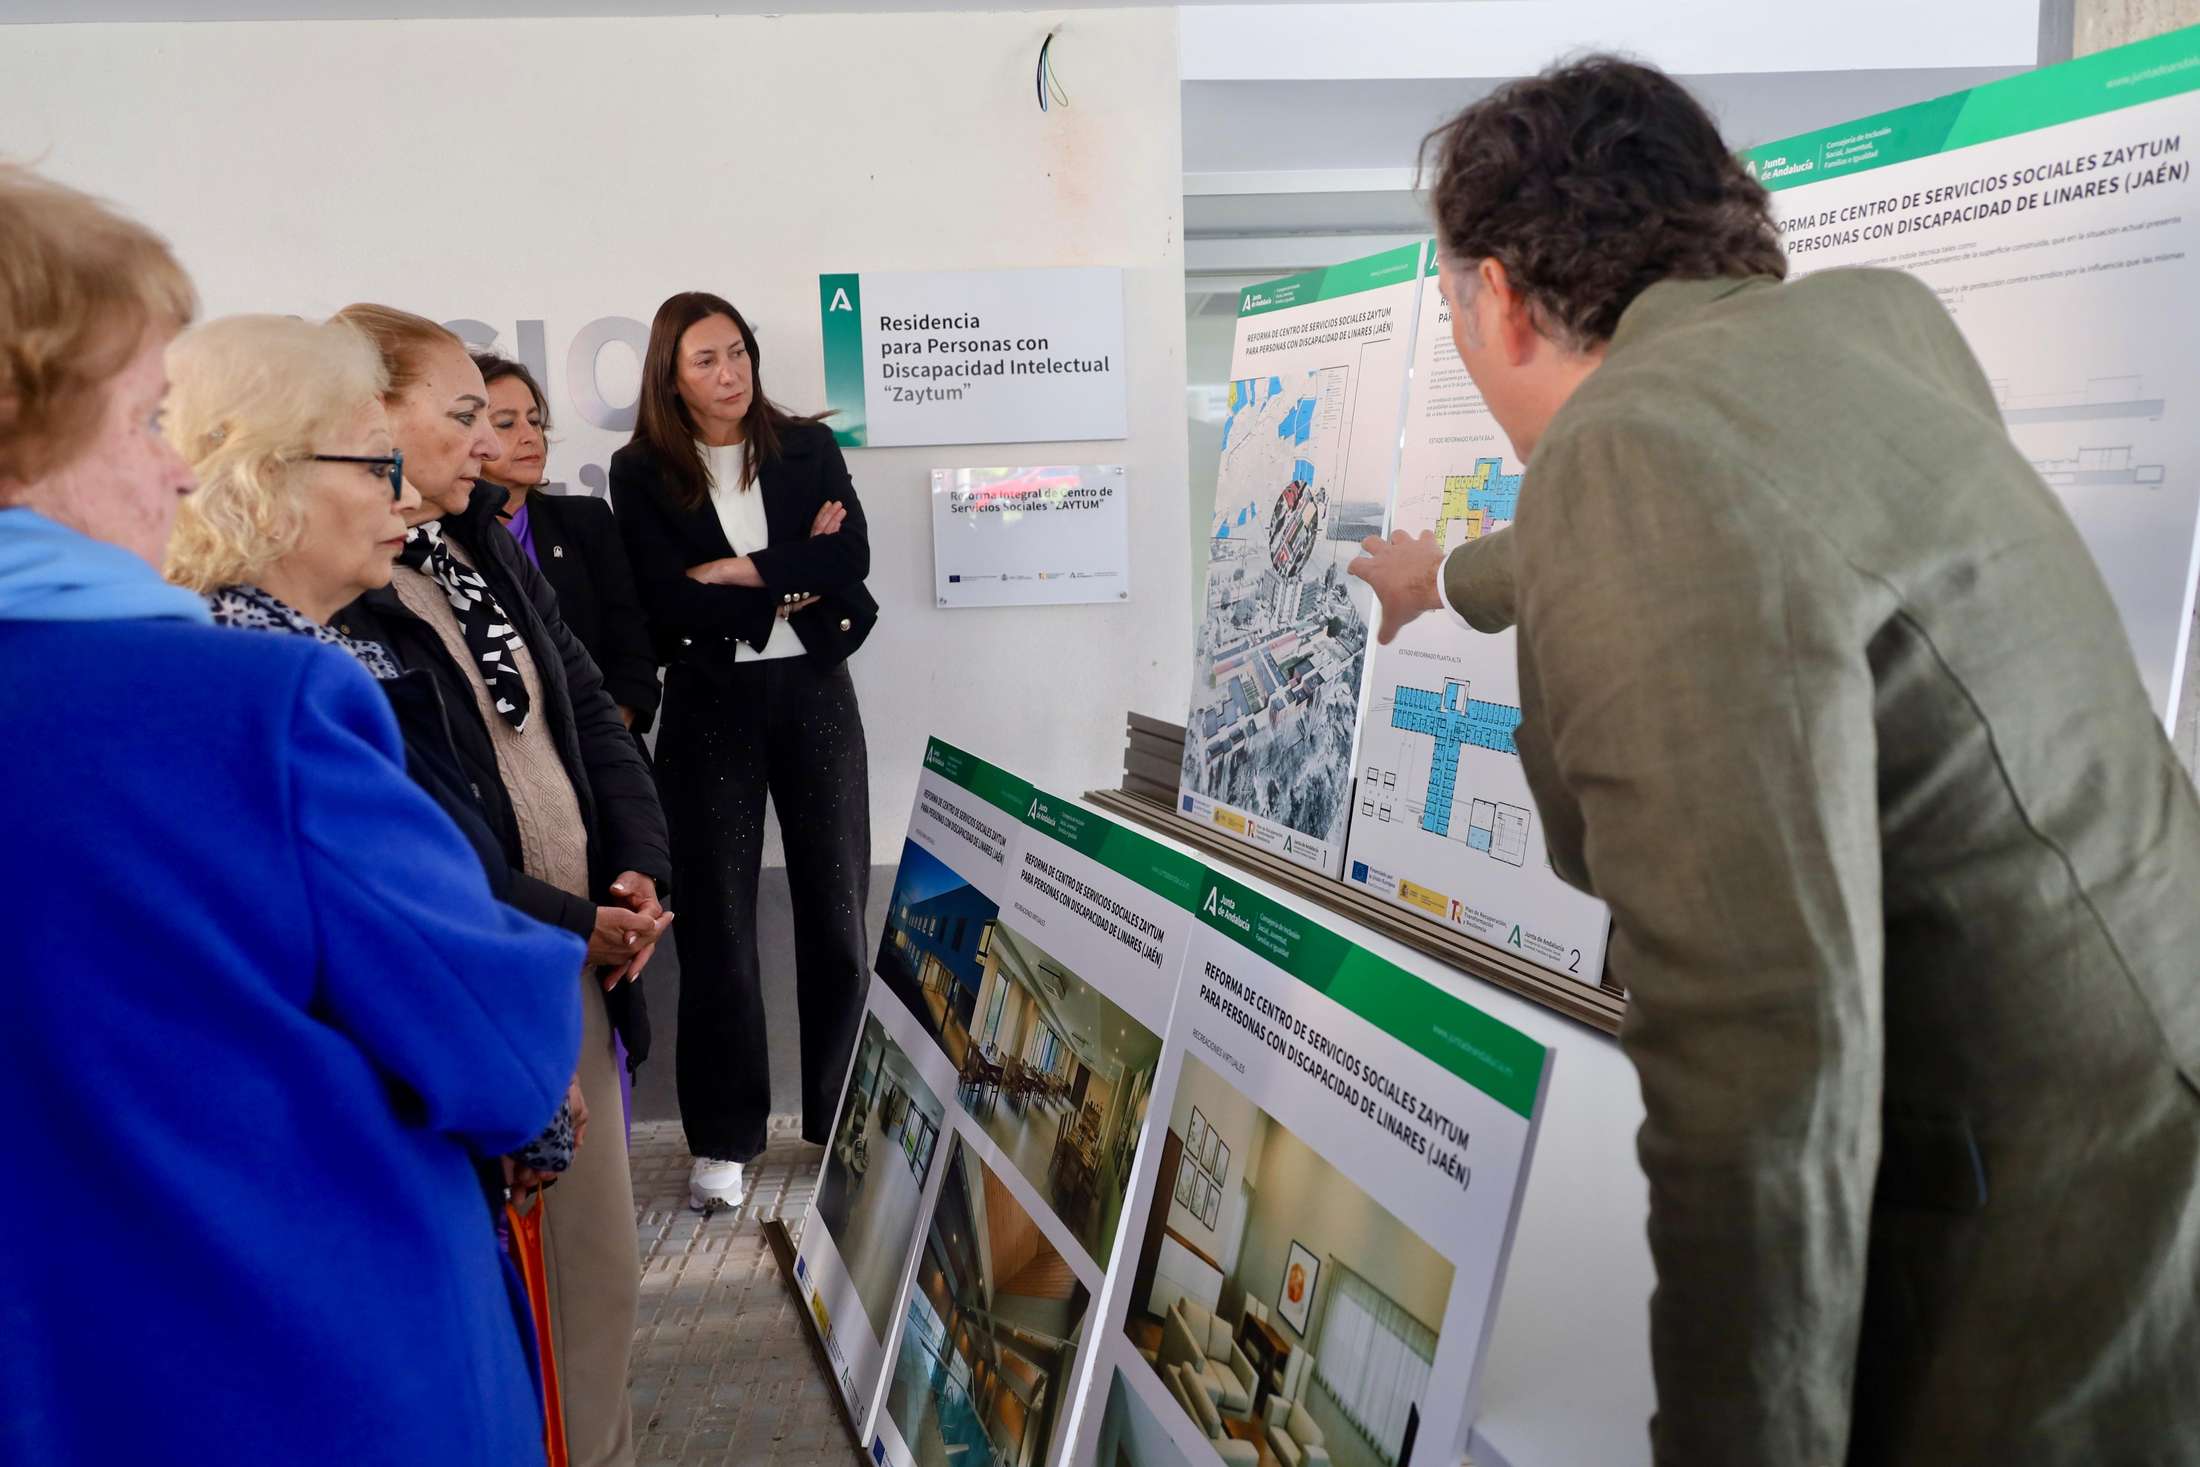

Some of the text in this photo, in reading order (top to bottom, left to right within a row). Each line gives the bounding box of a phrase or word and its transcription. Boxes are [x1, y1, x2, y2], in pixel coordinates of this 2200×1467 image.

[1761, 159, 1813, 180] de Andalucía
[1763, 157, 1786, 169] Junta
[1776, 134, 2182, 233] ORMA DE CENTRO DE SERVICIOS SOCIALES ZAYTUM
[1787, 161, 2192, 255] PERSONAS CON DISCAPACIDAD DE LINARES (JAÉN)
[880, 312, 981, 332] Residencia
[1247, 307, 1391, 342] REFORMA DE CENTRO DE SERVICIOS SOCIALES ZAYTUM
[881, 336, 1049, 358] para Personas con
[1246, 320, 1393, 355] PARA PERSONAS CON DISCAPACIDAD DE LINARES (JAÉN)
[882, 355, 1110, 381] Discapacidad Intelectual
[1099, 487, 1113, 497] de
[951, 502, 1001, 513] Servicios
[1003, 501, 1048, 511] Sociales
[1024, 852, 1164, 943] REFORMA DE CENTRO DE SERVICIOS SOCIALES ZAYTUM
[1221, 895, 1236, 910] Junta
[1020, 869, 1163, 968] PARA PERSONAS CON DISCAPACIDAD DE LINARES (JAÉN)
[1218, 906, 1250, 931] de Andalucía
[1525, 931, 1537, 941] Junta
[1568, 949, 1581, 974] 2
[1193, 1028, 1246, 1074] RECREACIONES VIRTUALES
[1204, 960, 1470, 1151] REFORMA DE CENTRO DE SERVICIOS SOCIALES ZAYTUM
[1199, 984, 1472, 1192] PARA PERSONAS CON DISCAPACIDAD DE LINARES (JAÉN)
